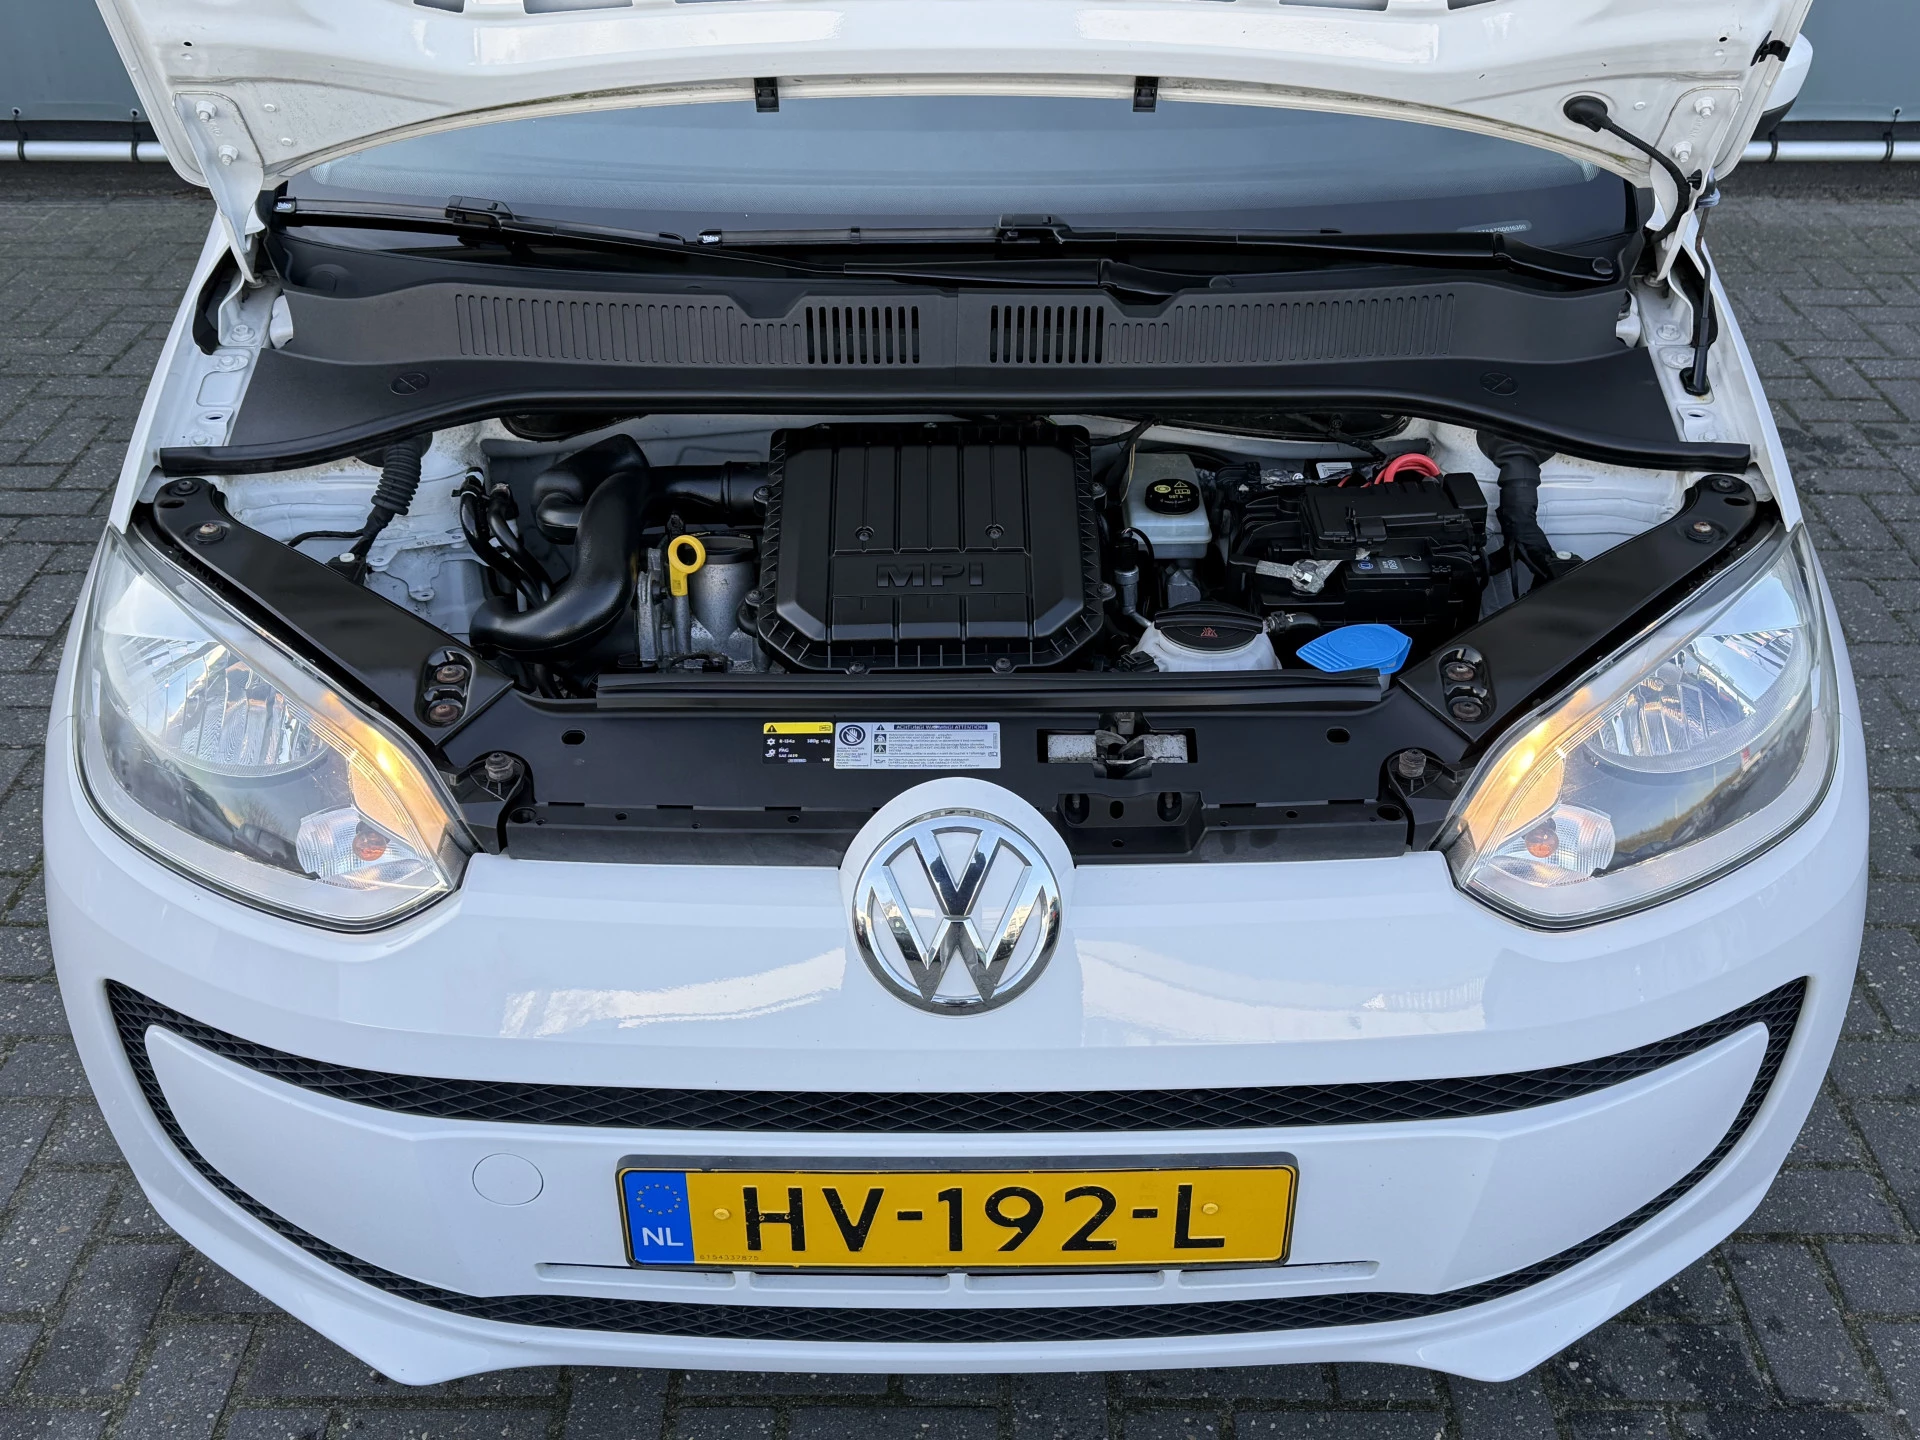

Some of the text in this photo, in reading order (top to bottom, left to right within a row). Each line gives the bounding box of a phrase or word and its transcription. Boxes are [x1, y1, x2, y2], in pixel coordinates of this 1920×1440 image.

[702, 235, 719, 244] Valeo
[877, 562, 983, 588] MPI
[743, 1184, 1226, 1252] HV-192-L
[641, 1226, 684, 1247] NL
